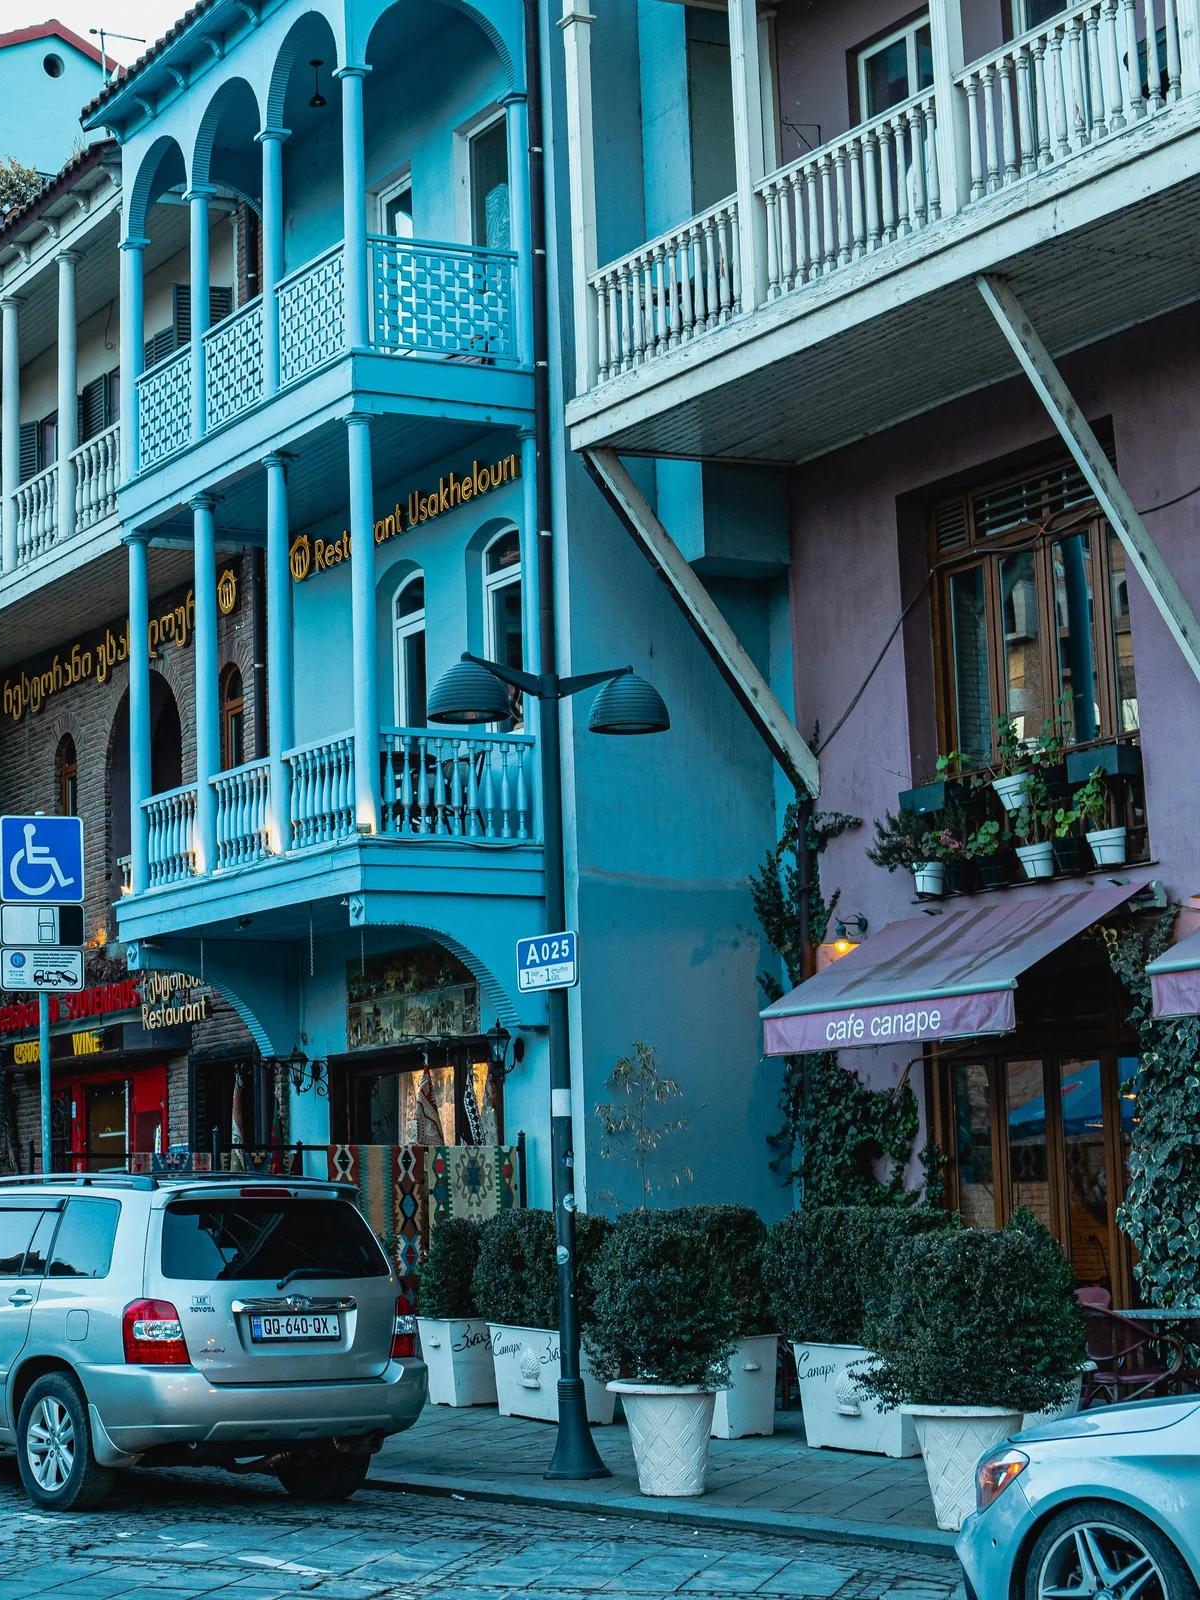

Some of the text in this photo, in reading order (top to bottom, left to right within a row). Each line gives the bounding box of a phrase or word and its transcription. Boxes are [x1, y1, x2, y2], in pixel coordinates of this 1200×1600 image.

[315, 454, 516, 572] Restant Usakhelouri
[3, 588, 195, 721] რესტორანი უსალოურ
[141, 995, 206, 1031] Restaurant
[826, 1010, 941, 1041] cafe canape
[14, 1041, 41, 1064] ღვინ
[72, 1031, 101, 1056] WINE
[264, 1317, 329, 1336] QQ-640-QX
[797, 1350, 836, 1382] Canape
